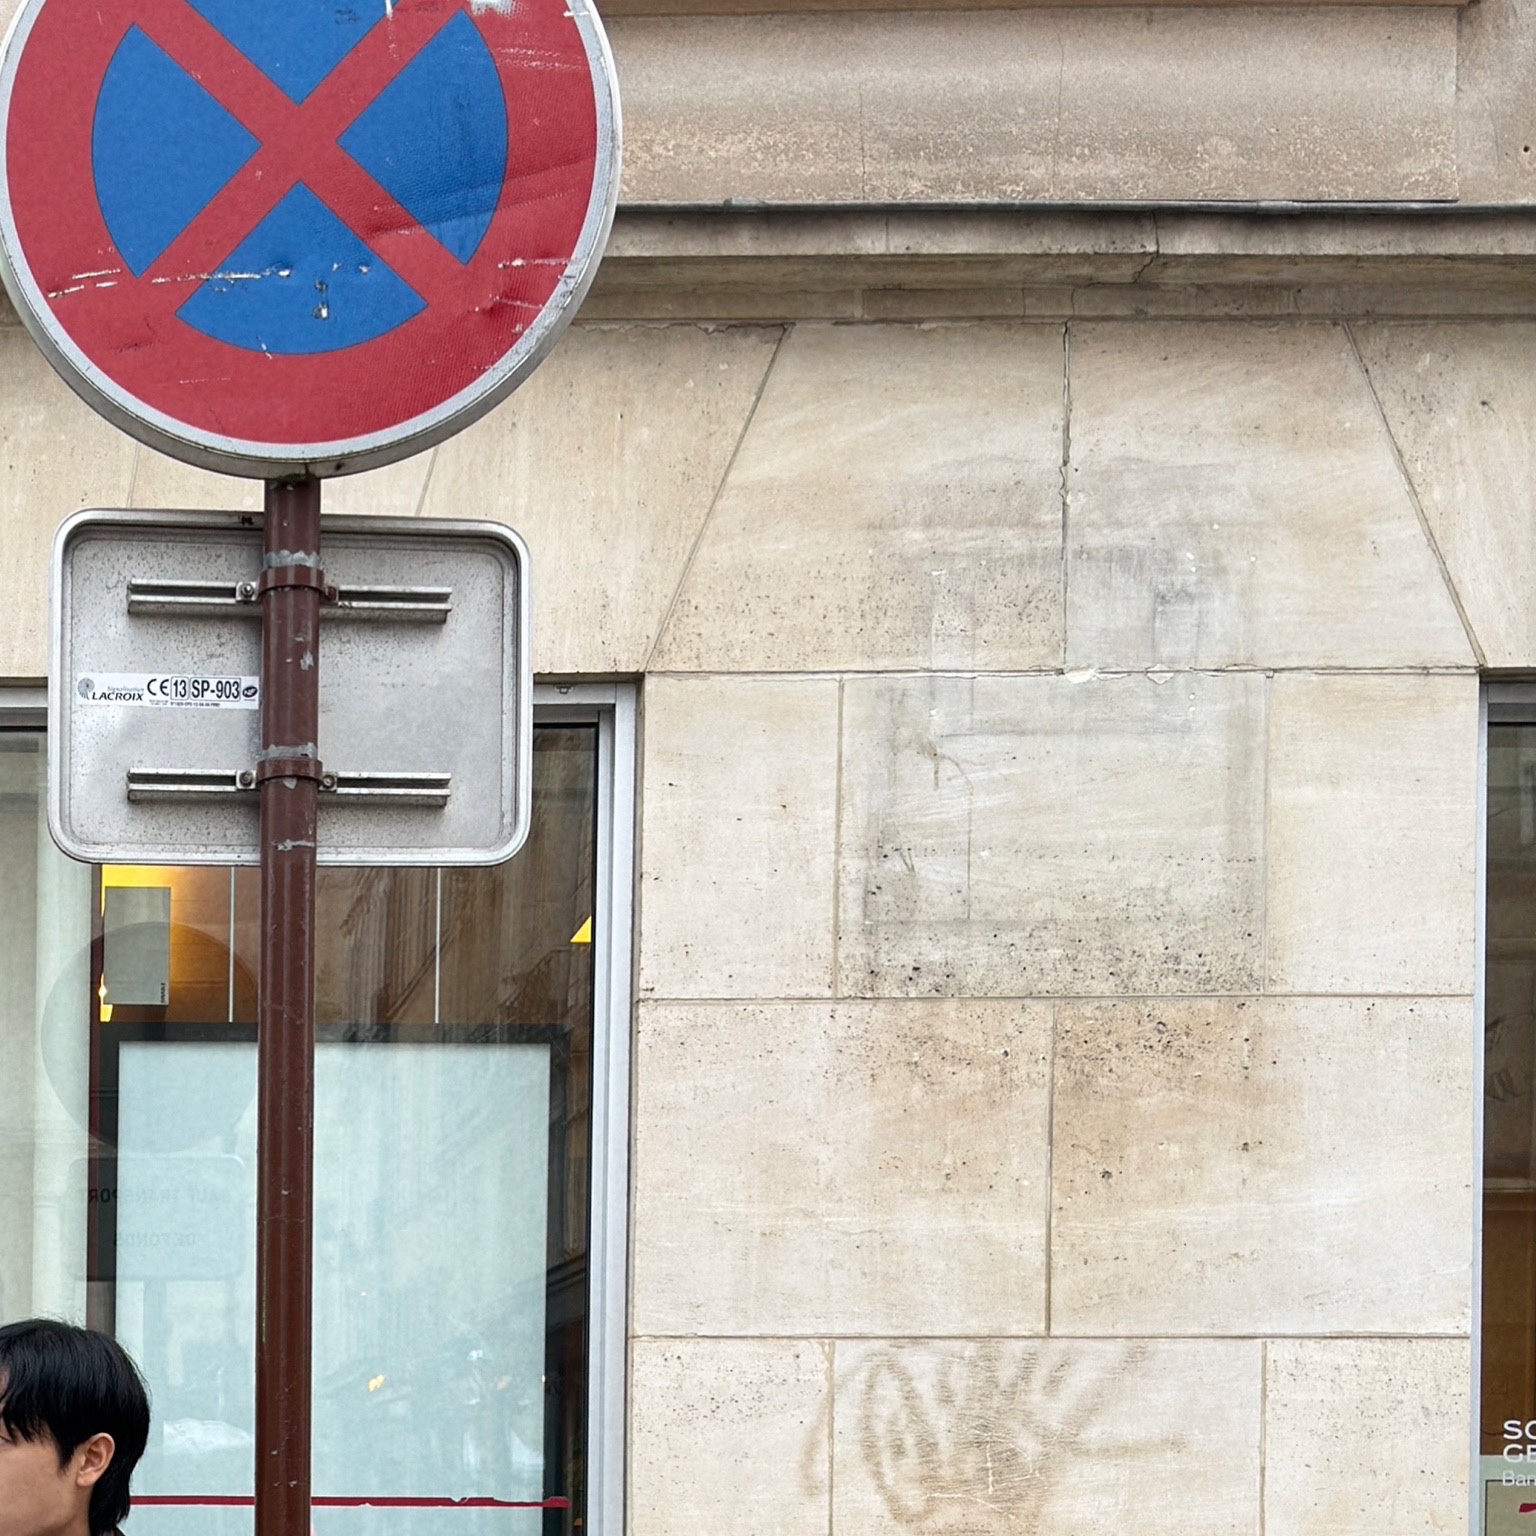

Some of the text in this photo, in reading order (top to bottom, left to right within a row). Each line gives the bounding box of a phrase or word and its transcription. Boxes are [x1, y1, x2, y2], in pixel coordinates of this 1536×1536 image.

[92, 691, 144, 701] LACROIX
[147, 678, 169, 696] CE
[173, 679, 187, 698] 13
[191, 679, 240, 699] SP-903
